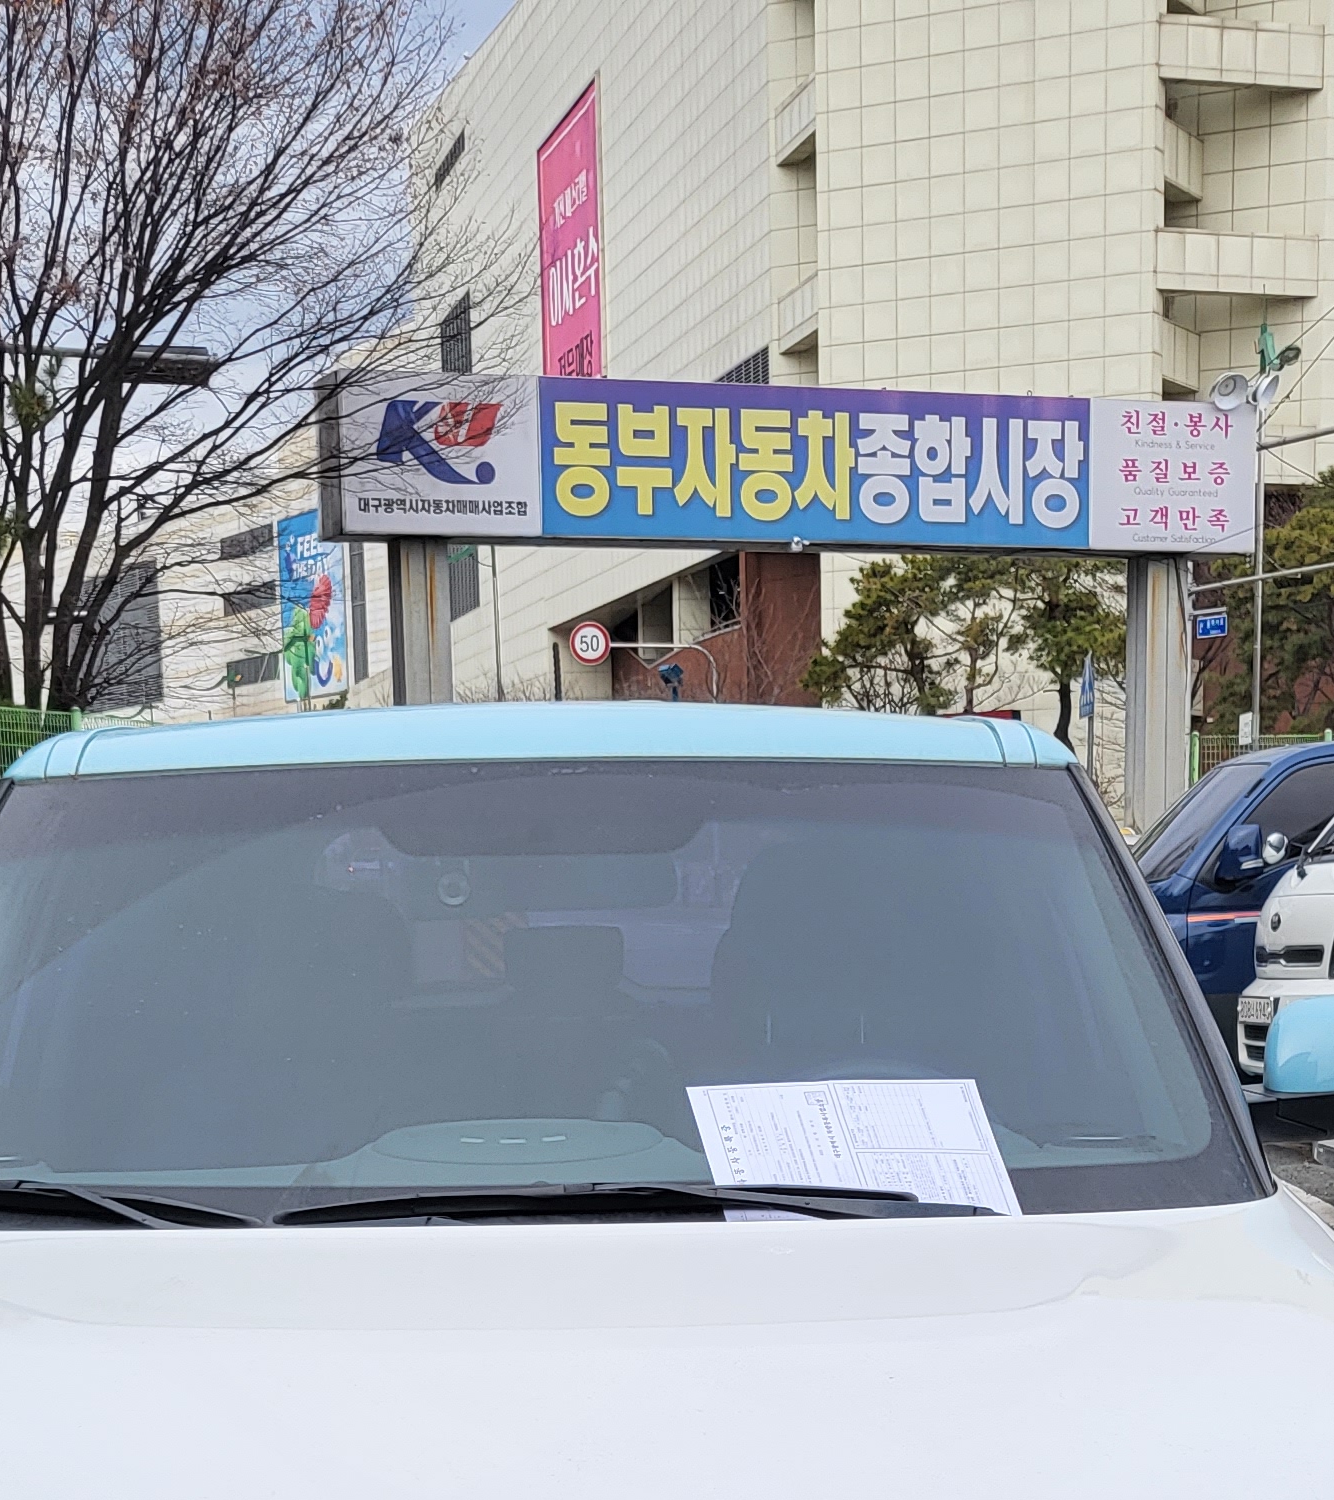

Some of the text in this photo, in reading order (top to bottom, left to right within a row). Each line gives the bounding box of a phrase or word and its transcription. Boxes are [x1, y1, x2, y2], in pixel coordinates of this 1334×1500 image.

[549, 225, 599, 327] 이사혼수
[1134, 439, 1216, 451] Kindness & Service
[553, 400, 1084, 529] 동부자동차종합시장
[1133, 486, 1219, 498] Quality Guaranteed
[358, 497, 528, 517] 대구광역시자동차매매사업조합
[1132, 534, 1217, 545] Customer Satisfaction
[579, 634, 600, 653] 50
